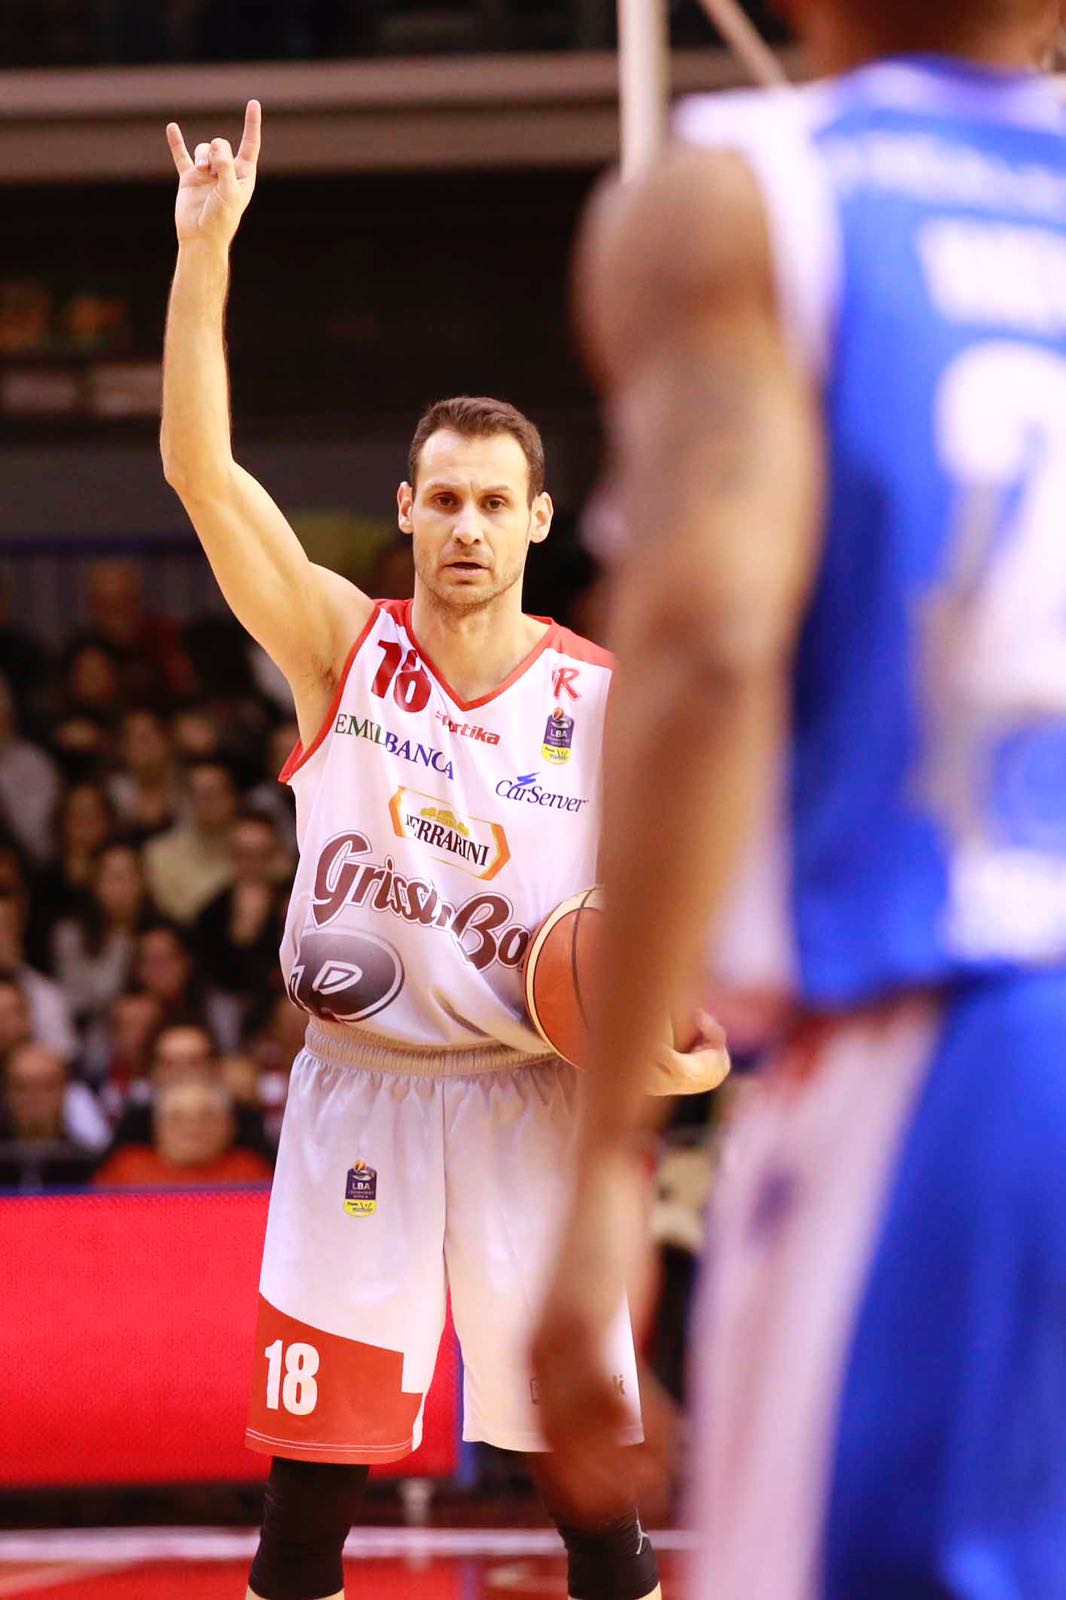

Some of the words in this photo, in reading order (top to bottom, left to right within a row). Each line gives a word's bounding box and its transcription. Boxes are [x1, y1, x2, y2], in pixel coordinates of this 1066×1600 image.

[334, 713, 455, 780] EMILBANCA
[550, 728, 569, 739] LBA
[352, 1182, 371, 1191] LBA
[263, 1338, 321, 1416] 18
